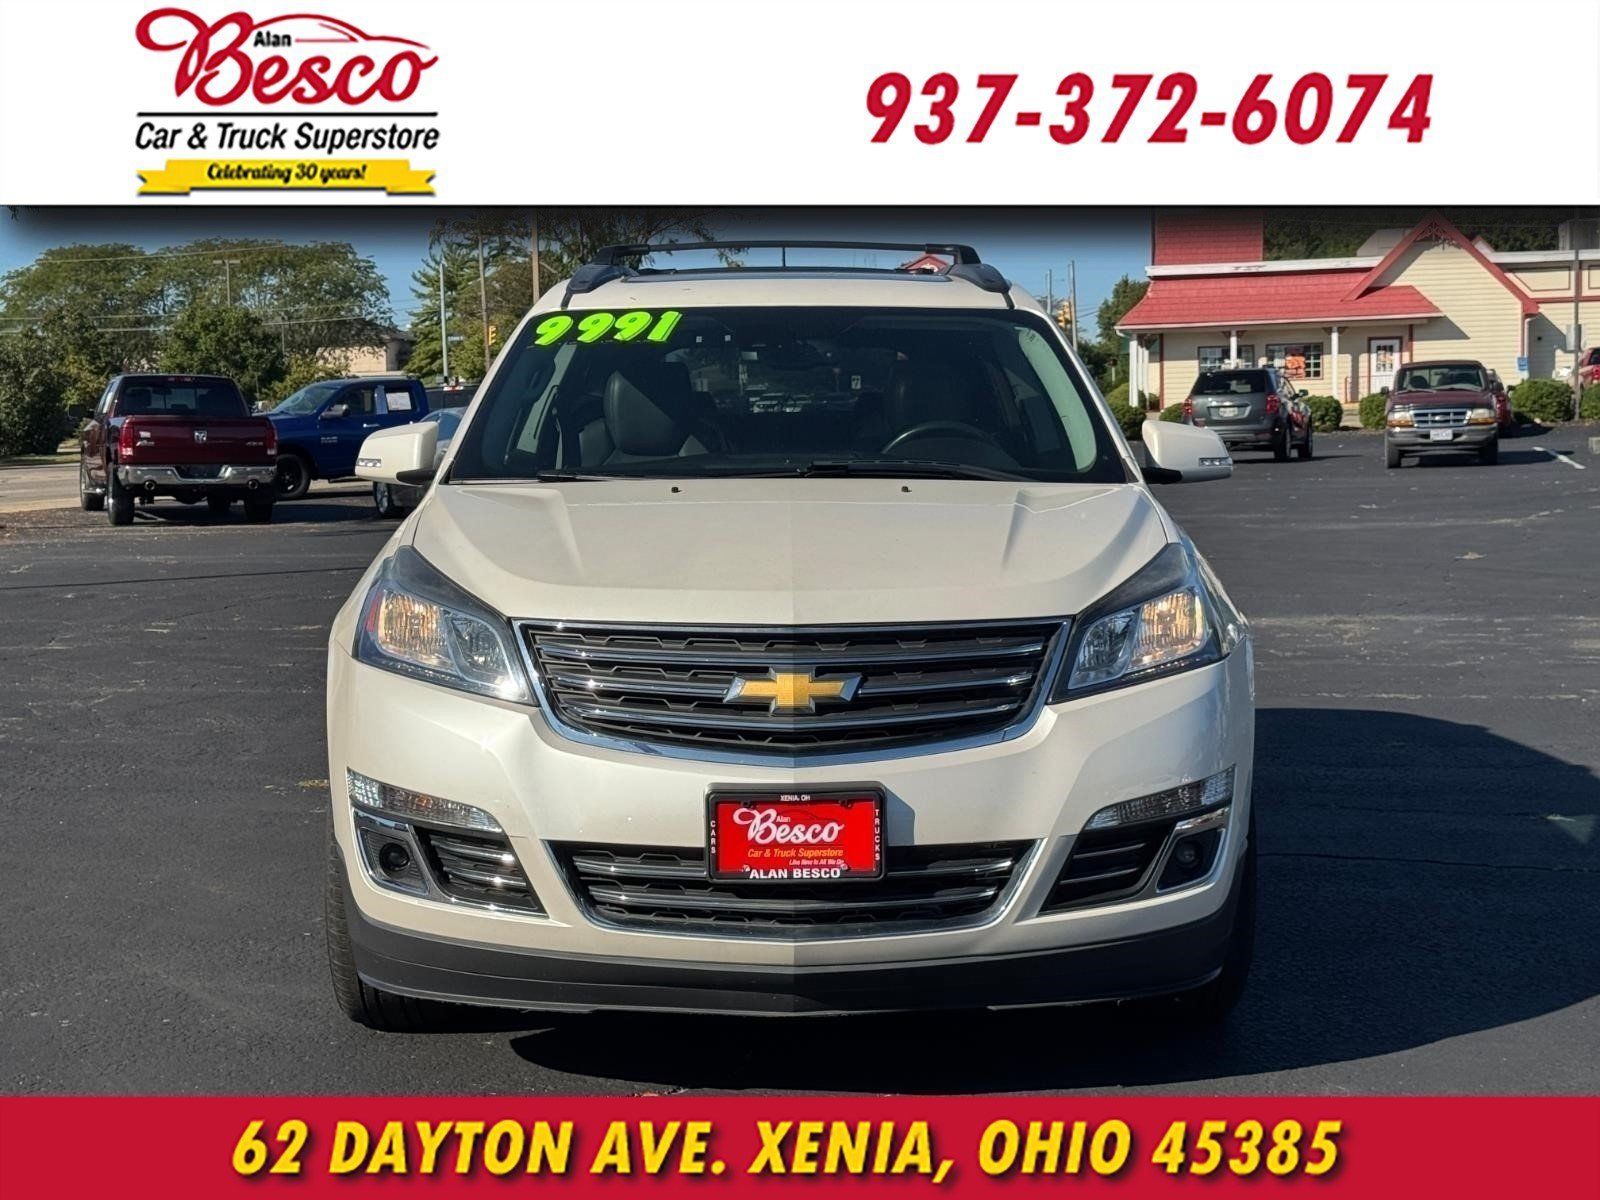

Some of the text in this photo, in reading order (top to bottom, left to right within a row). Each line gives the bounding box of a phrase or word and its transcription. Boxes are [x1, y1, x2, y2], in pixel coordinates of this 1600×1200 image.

[534, 310, 683, 346] 9991
[776, 815, 791, 823] Alan
[733, 807, 845, 845] Besco
[748, 848, 844, 859] Car & Truck Superstore
[749, 868, 841, 879] ALAN BESCO
